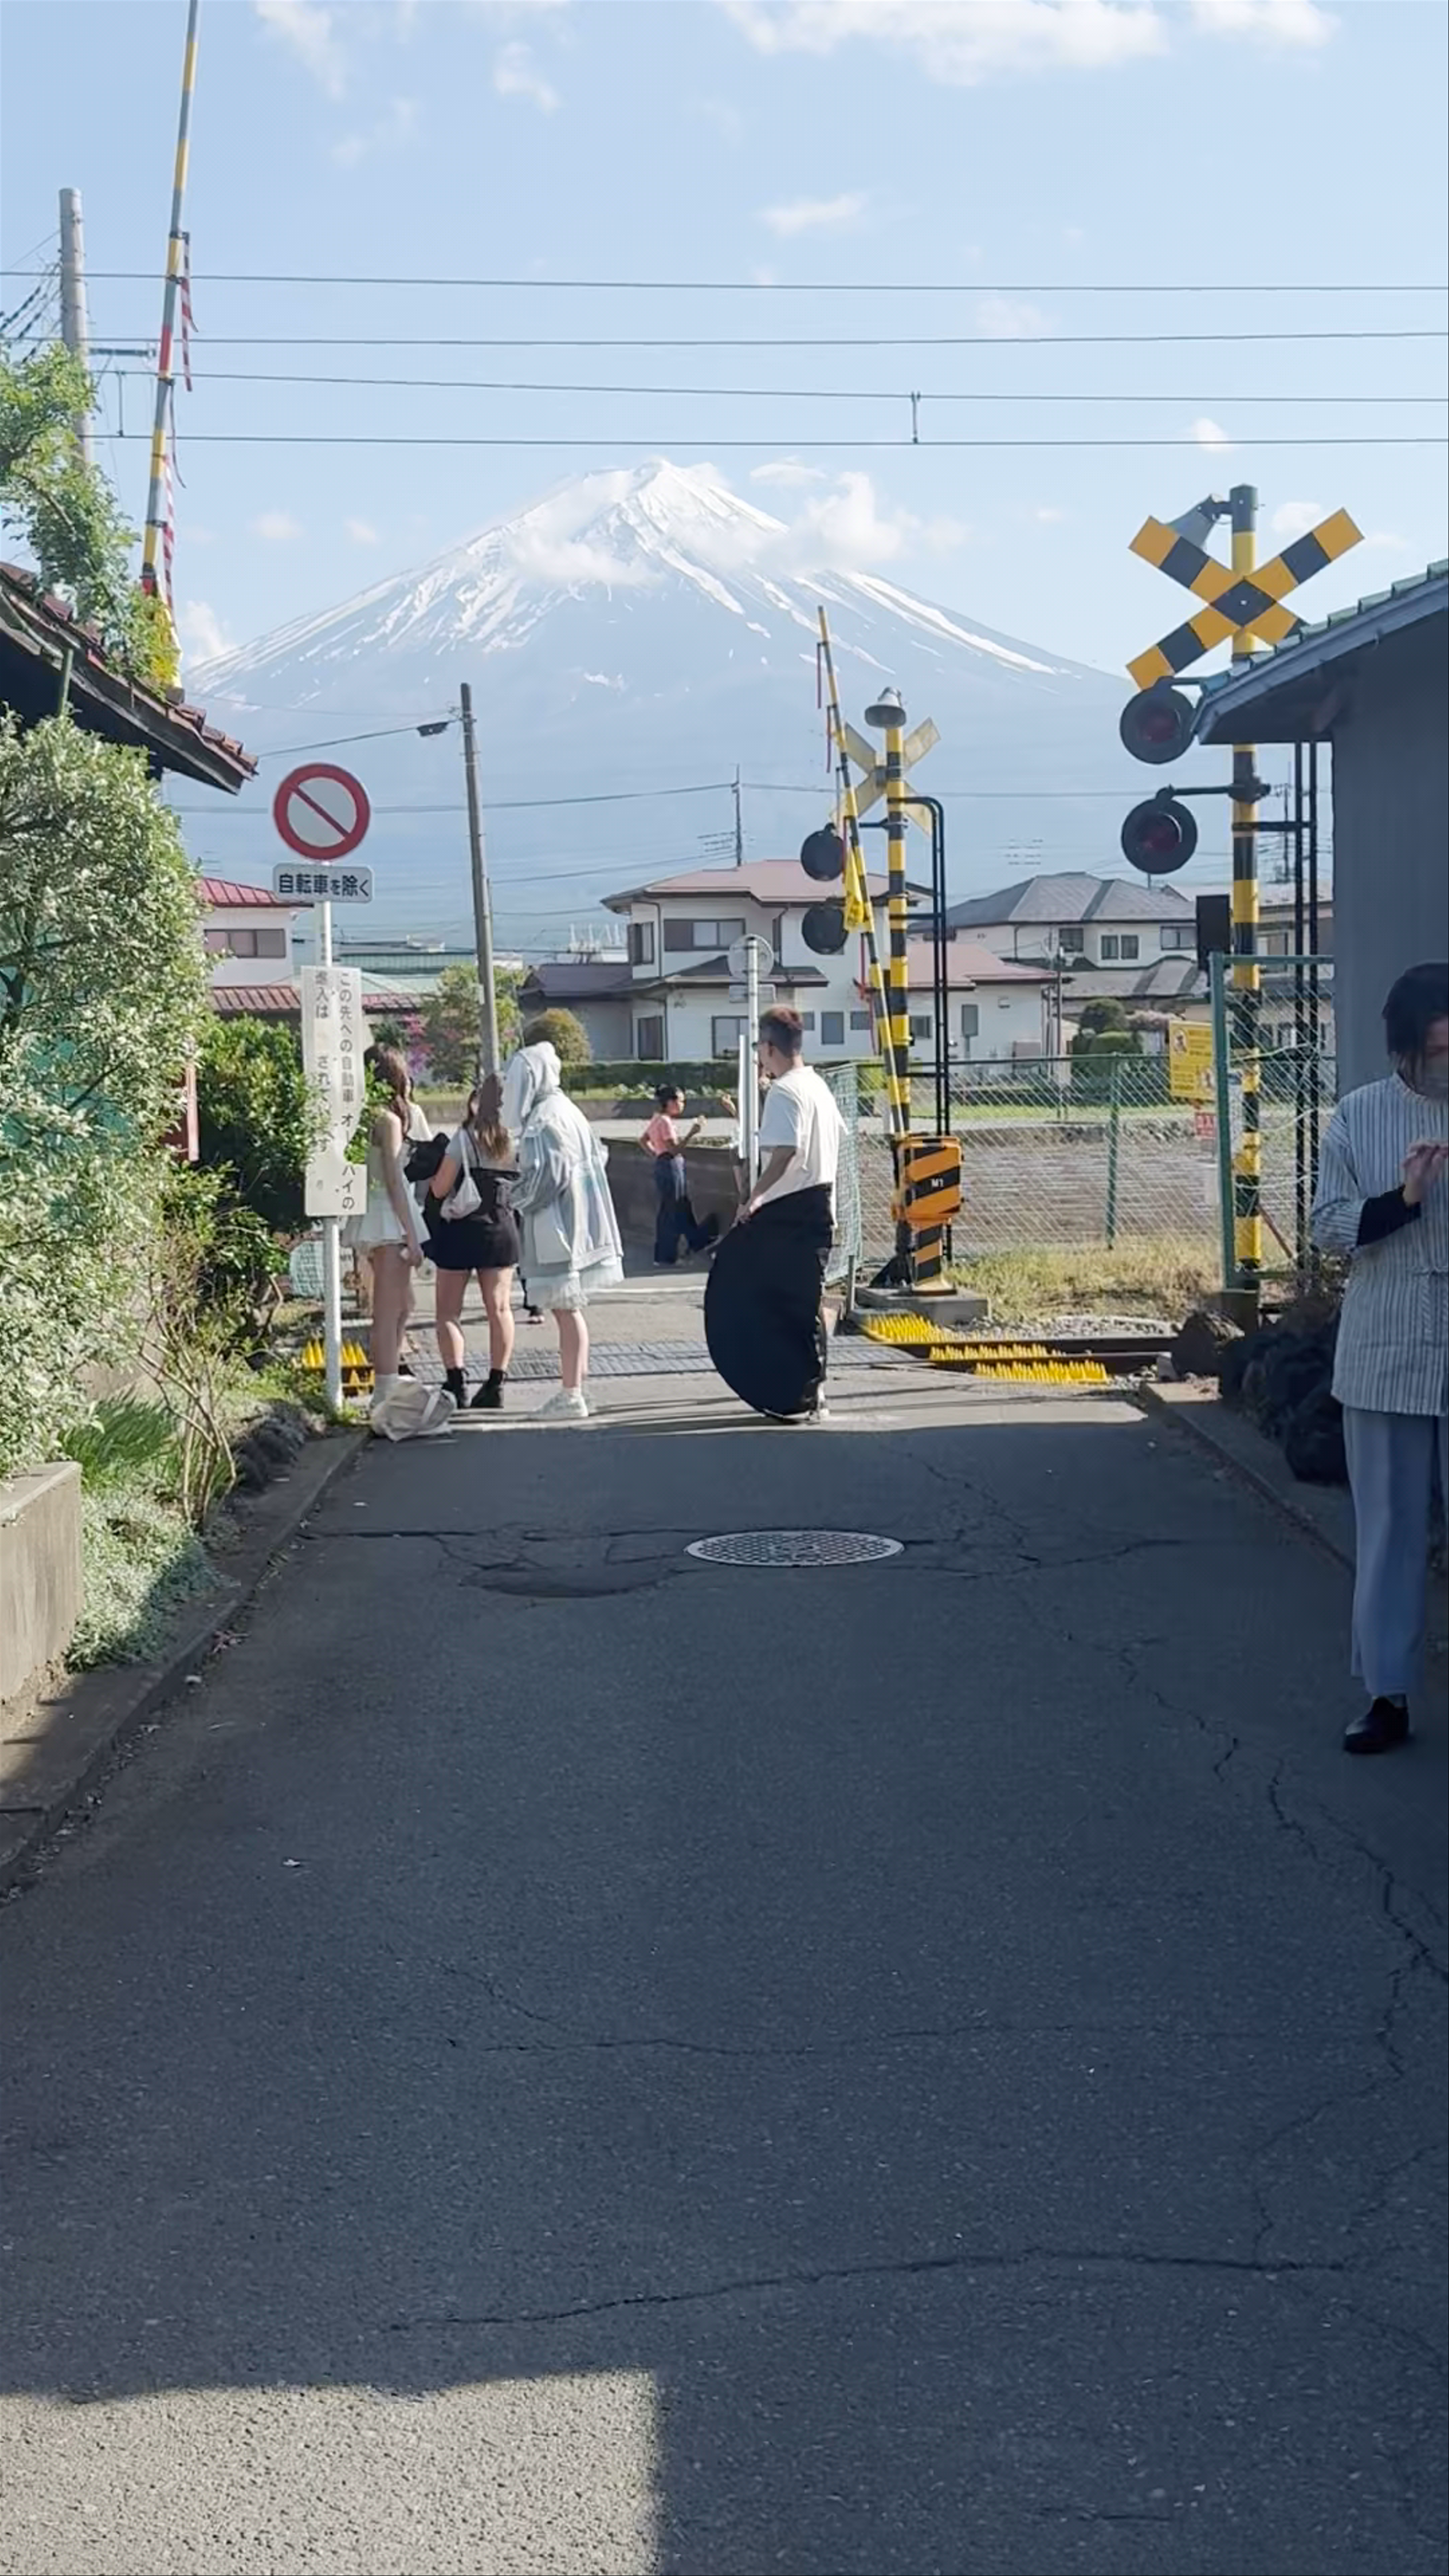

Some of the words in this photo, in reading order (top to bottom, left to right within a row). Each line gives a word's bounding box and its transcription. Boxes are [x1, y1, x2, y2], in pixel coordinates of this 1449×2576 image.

[279, 873, 369, 897] 自転車を除く
[931, 1178, 943, 1187] M1
